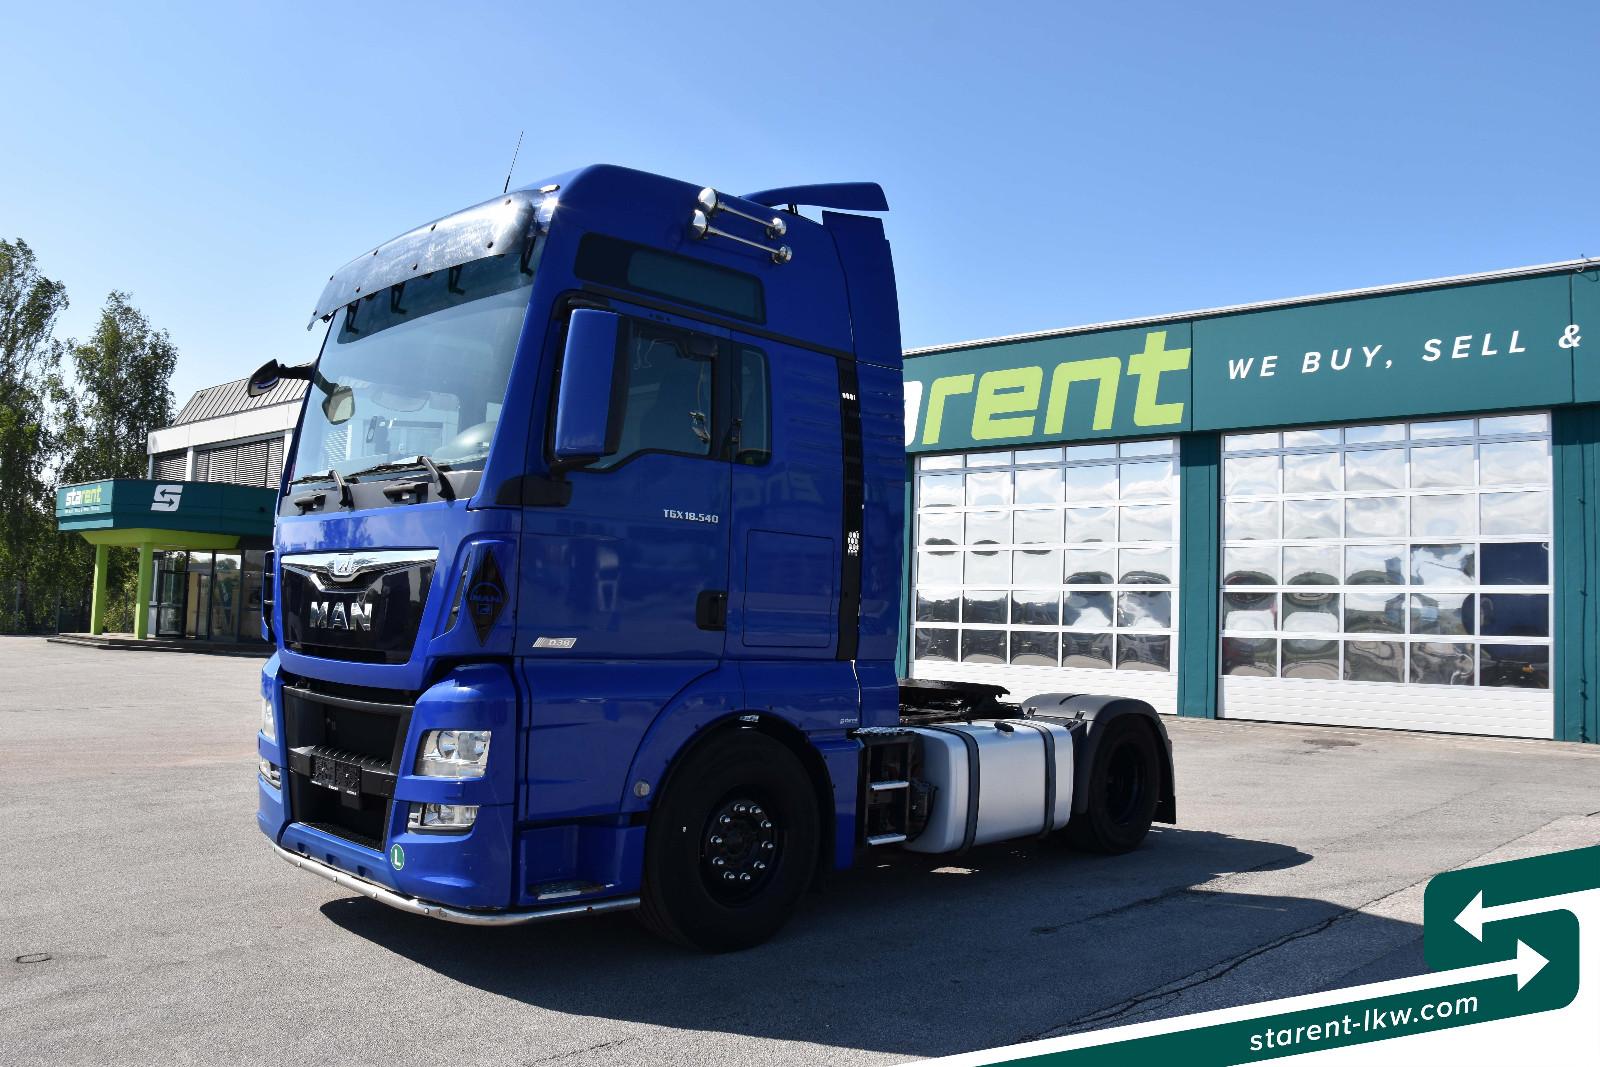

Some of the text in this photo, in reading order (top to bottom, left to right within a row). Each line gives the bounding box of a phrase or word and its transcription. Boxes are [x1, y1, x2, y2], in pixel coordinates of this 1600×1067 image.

[1228, 324, 1582, 380] WE BUY, SELL &
[65, 485, 102, 506] starent
[663, 508, 719, 524] TGX 18.540
[309, 602, 373, 631] MAN
[394, 848, 402, 867] L
